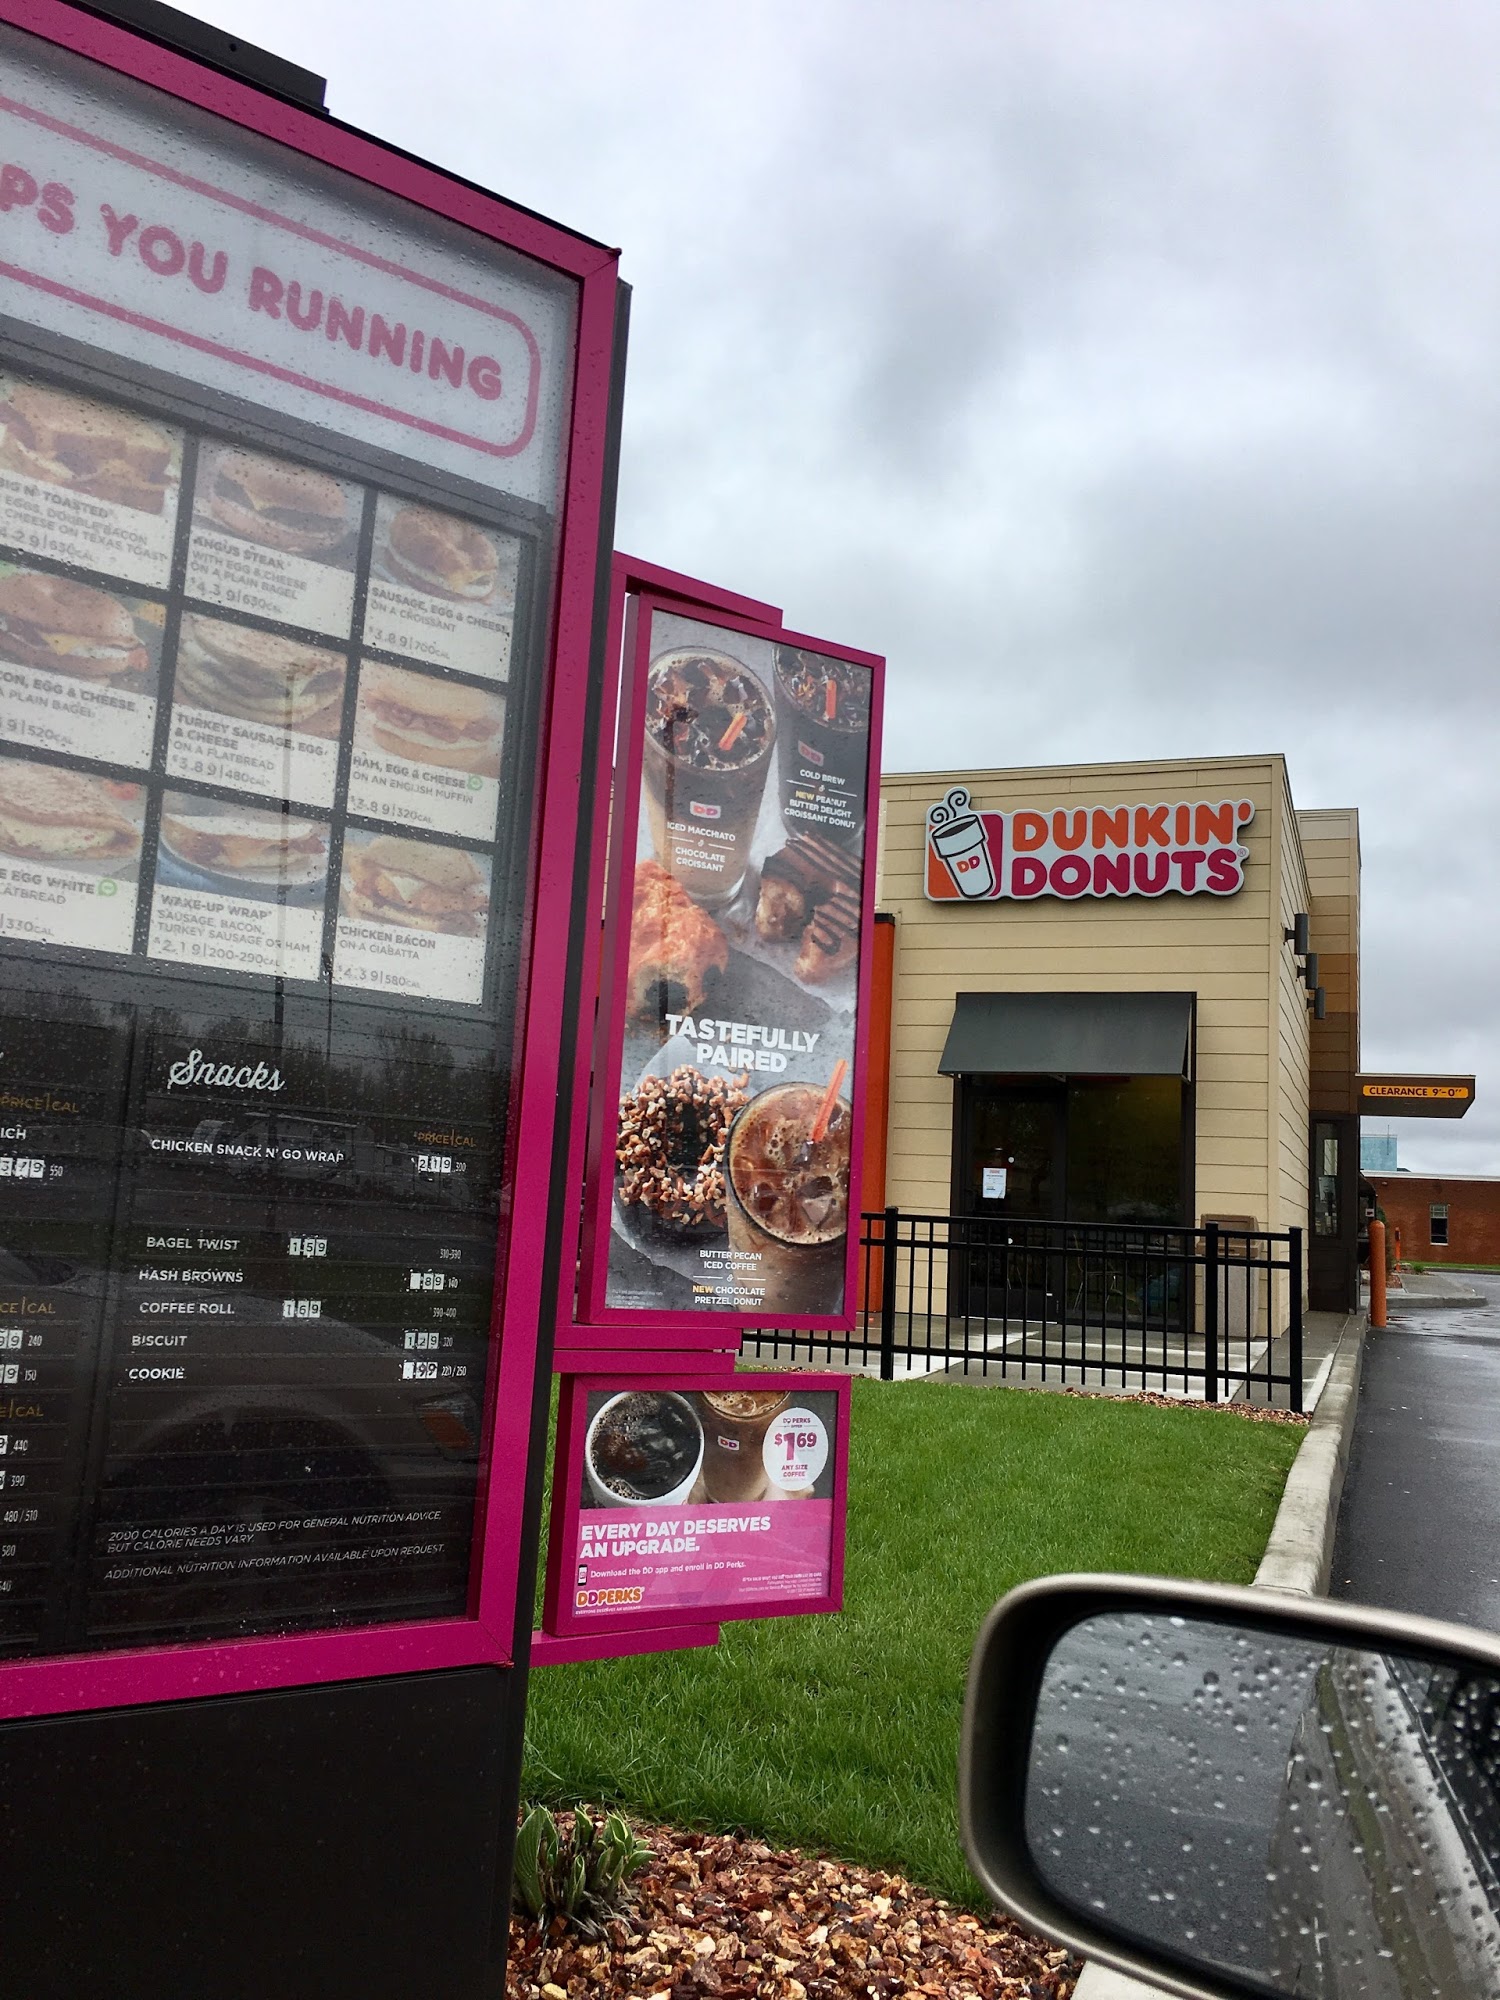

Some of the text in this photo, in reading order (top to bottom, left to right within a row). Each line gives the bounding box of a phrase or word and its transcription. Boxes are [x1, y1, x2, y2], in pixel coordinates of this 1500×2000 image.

[0, 164, 502, 400] PS YOU RUNNING
[5, 508, 55, 531] CHEESE
[58, 525, 78, 537] ON
[81, 531, 122, 550] TEXAS
[47, 507, 100, 531] DOUBLE
[103, 524, 148, 545] BACON
[192, 536, 285, 571] ANGUS STEAK
[190, 561, 298, 600] ON PLAIN BAGEL
[192, 550, 307, 591] WITH EGG & CHEESE
[371, 600, 456, 632] ON CROISSANT
[430, 605, 454, 619] EGG
[8, 689, 49, 707] PLAIN
[52, 700, 92, 718] BAGEL
[33, 678, 136, 712] EGG & CHEESE
[175, 728, 239, 750] & CHEESE
[177, 713, 323, 756] TURKEY SAUSAGE, EGG
[173, 740, 275, 771] ON A FLATBREAD
[385, 763, 409, 777] EGG
[412, 771, 420, 779] &
[422, 772, 466, 789] CHEESE
[800, 769, 845, 785] COLD BREW
[352, 771, 474, 805] ON AN ENGLISH MUFFIN
[795, 790, 846, 807] NEW PEANUT
[784, 808, 856, 829] CROISSANT DONUT
[789, 799, 852, 818] BUTTER DELIGHT
[667, 821, 736, 841] ICED MACCHIATO
[1012, 802, 1250, 852] DUNKIN'
[675, 846, 725, 862] CHOCOLATE
[676, 857, 724, 872] CROISSANT
[956, 855, 980, 874] DD
[11, 870, 95, 894] EGG WHITE
[1011, 848, 1239, 896] DONUTS
[161, 894, 224, 913] WAKE-UP
[158, 921, 310, 952] TURKEY SAUSAGE OR HAM
[220, 920, 265, 935] BACON,
[339, 926, 436, 949] CHICKEN BACON
[339, 940, 420, 960] ON A CIABATTA
[665, 1013, 820, 1053] TASTEFULLY
[696, 1043, 787, 1073] PAIRED
[167, 1049, 286, 1091] Snacks
[1369, 1087, 1427, 1096] CLEARANCE
[151, 1140, 213, 1154] CHICKEN
[217, 1144, 261, 1158] SNACK
[282, 1149, 301, 1160] GO
[306, 1151, 344, 1164] WRAP
[146, 1237, 240, 1250] BAGEL TWIST
[699, 1250, 762, 1260] BUTTER PECAN
[703, 1261, 757, 1270] ICED COFFEE
[139, 1269, 244, 1283] HASH BROWNS
[692, 1285, 766, 1295] NEW CHOCOLATE
[694, 1296, 763, 1306] PRETZEL DONUT
[139, 1302, 234, 1314] COFFEE ROLL
[131, 1335, 188, 1346] BISCUIT
[129, 1368, 184, 1379] COOKIE
[108, 1511, 442, 1541] 2000 CALORIES A DAY IS USED FOR GENERAL NUTRITION ADVICE.
[581, 1516, 771, 1541] EVERY DAY DESERVES
[107, 1534, 255, 1553] BUT CALORIE NEEDS VARY.
[579, 1537, 700, 1559] AN UPGRADE.
[104, 1544, 445, 1580] ADDITIONAL NUTRITION INFORMATION AVAILABLE UPON REQUEST.
[591, 1568, 627, 1578] Download
[655, 1566, 668, 1574] app
[685, 1563, 705, 1572] enroll
[714, 1561, 724, 1569] DD
